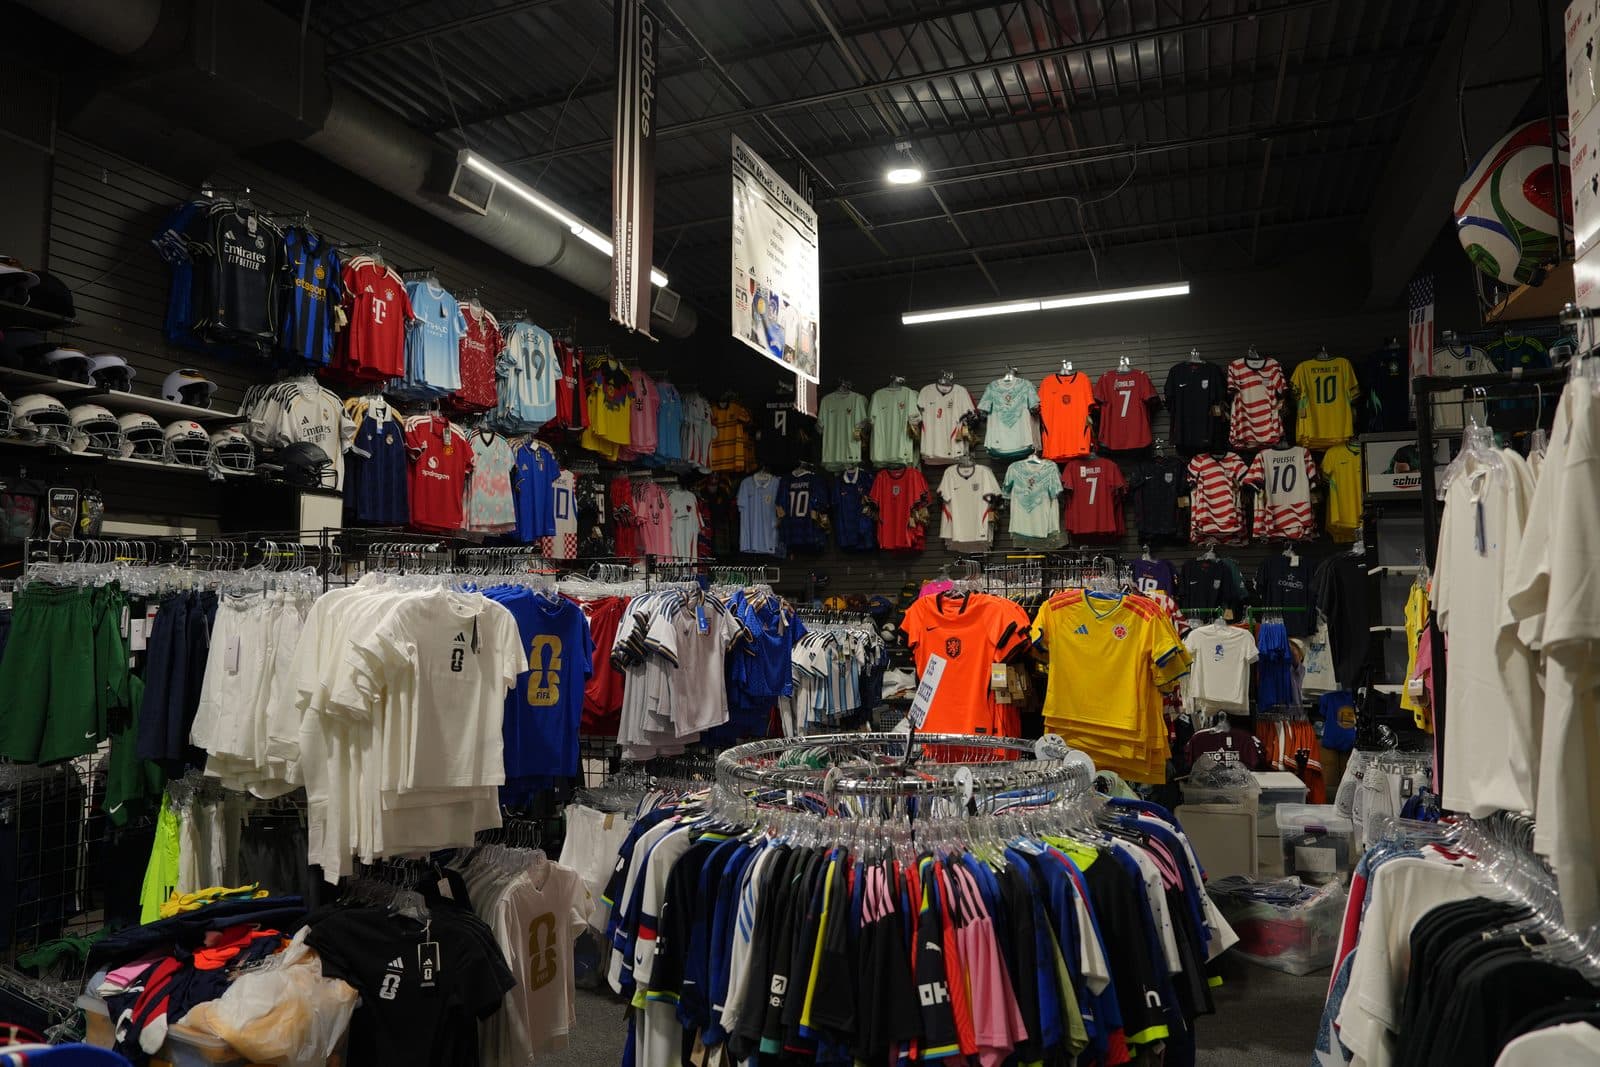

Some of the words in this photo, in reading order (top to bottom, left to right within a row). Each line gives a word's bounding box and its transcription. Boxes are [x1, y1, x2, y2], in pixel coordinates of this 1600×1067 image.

[639, 14, 656, 139] adidas
[736, 145, 755, 171] CUSTOM
[756, 166, 775, 193] APPAREL
[781, 189, 792, 208] TEAM
[793, 202, 813, 227] UNIFORMS
[224, 241, 267, 264] Emirates
[521, 347, 546, 381] 19
[1314, 375, 1337, 404] 10
[1119, 390, 1131, 418] 7
[774, 410, 787, 436] 9
[1272, 455, 1296, 464] PULISIC
[1085, 477, 1098, 505] 7
[1271, 464, 1297, 495] 10
[1392, 474, 1422, 486] schut
[789, 490, 809, 518] 10
